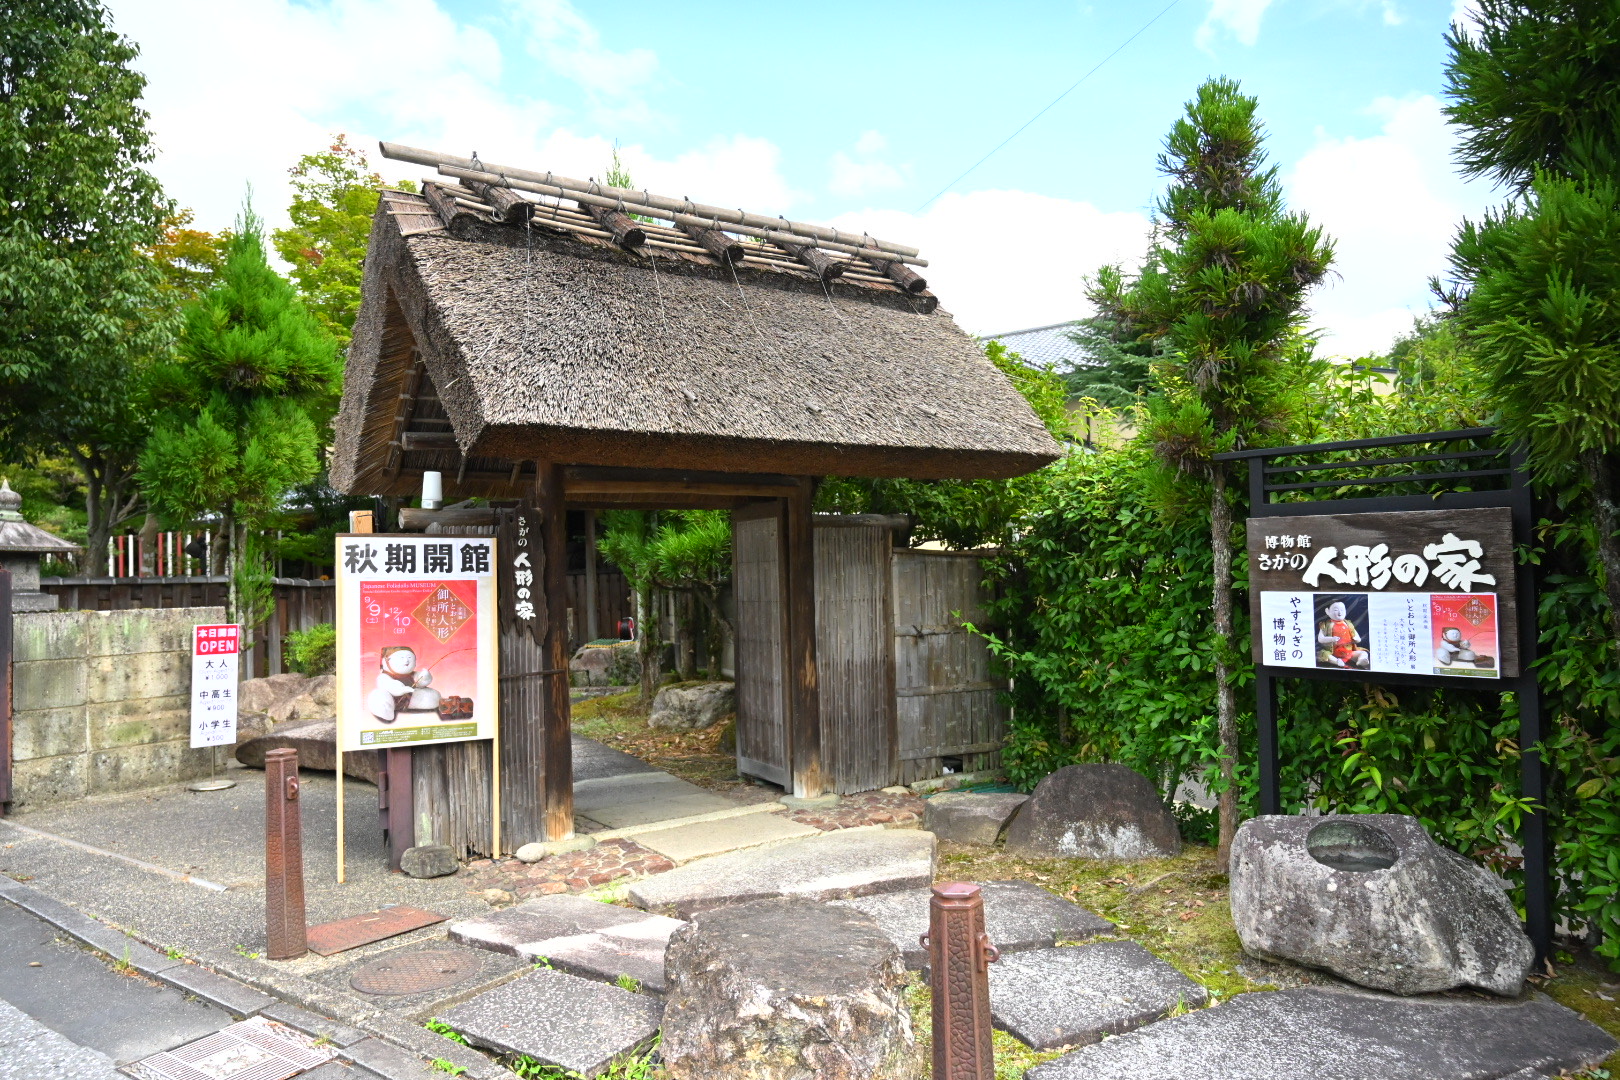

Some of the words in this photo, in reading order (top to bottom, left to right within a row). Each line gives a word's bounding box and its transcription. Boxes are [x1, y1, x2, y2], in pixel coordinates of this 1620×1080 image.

[518, 516, 530, 547] さがの
[1264, 534, 1312, 549] 博物館
[344, 543, 490, 574] 秋期開館
[1257, 551, 1307, 571] さがの
[1302, 532, 1496, 593] 人形の家
[513, 552, 536, 621] 人形の家
[437, 588, 450, 639] 御所人形
[450, 596, 458, 631] いとおしい
[1290, 596, 1303, 660] やすらぎの
[197, 627, 237, 639] 本日開館
[199, 639, 235, 653] OPEN
[1272, 617, 1287, 662] 博物館
[205, 658, 228, 669] 大人
[199, 688, 232, 700] 中高生
[198, 719, 232, 731] 小学生
